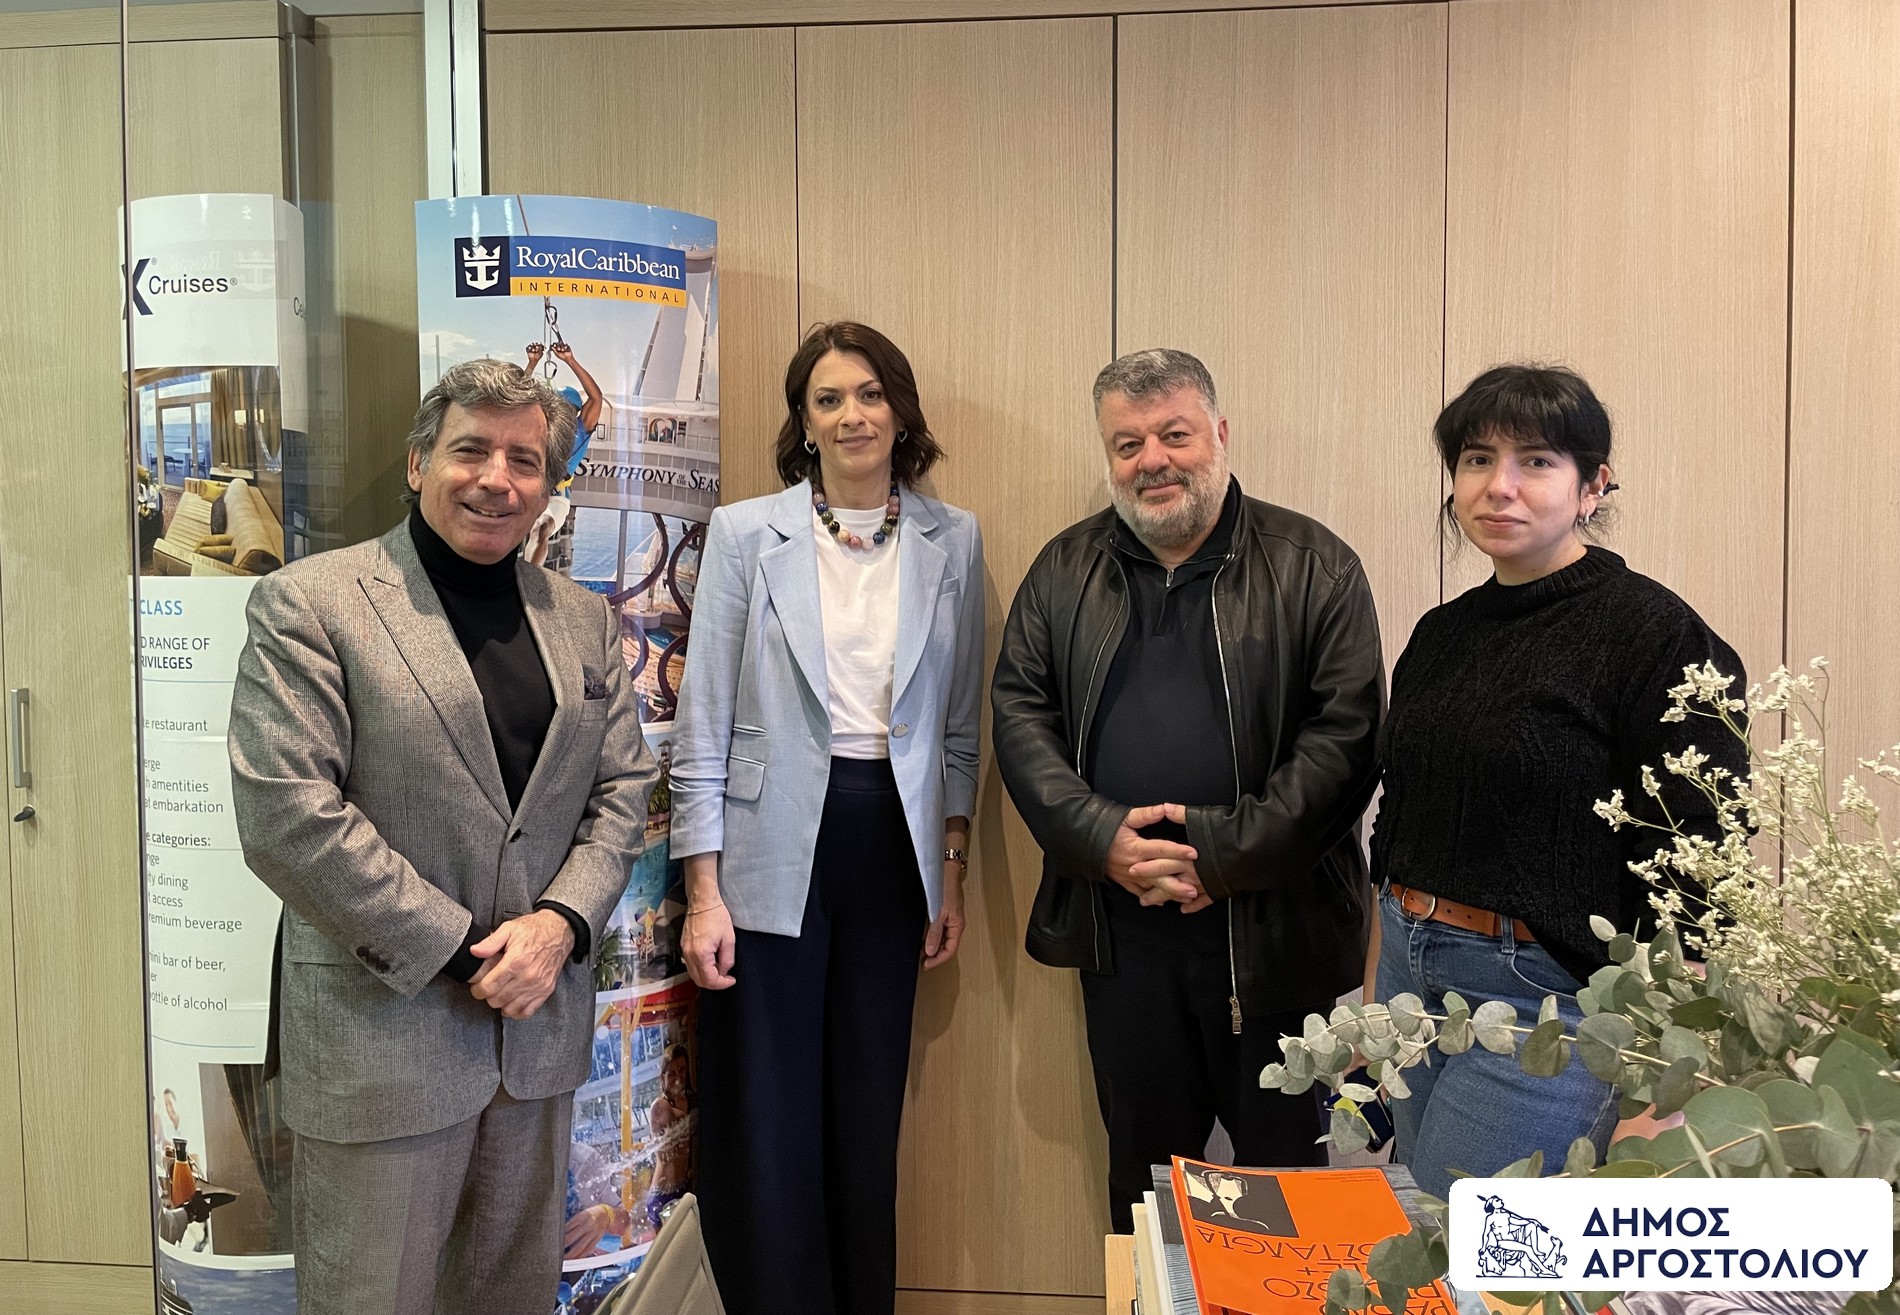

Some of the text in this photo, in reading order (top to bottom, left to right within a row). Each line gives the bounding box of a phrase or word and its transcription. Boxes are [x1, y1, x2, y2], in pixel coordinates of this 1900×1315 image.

[516, 246, 680, 280] RoyalCaribbean
[520, 281, 679, 303] INTERNATIONAL
[574, 457, 677, 485] SYMPHONY
[140, 599, 183, 615] CLASS
[149, 636, 188, 650] RANGE
[192, 637, 210, 650] OF
[141, 656, 193, 669] RIVILEGES
[151, 719, 208, 732] restaurant
[152, 779, 209, 793] amentities
[153, 798, 224, 813] embarkation
[152, 832, 211, 848] categories:
[158, 873, 189, 891] dining
[152, 894, 183, 908] access
[149, 913, 242, 933] remium beverage
[163, 952, 179, 967] bar
[181, 956, 193, 969] of
[195, 957, 226, 972] beer,
[150, 991, 227, 1011] ottle of alcohol
